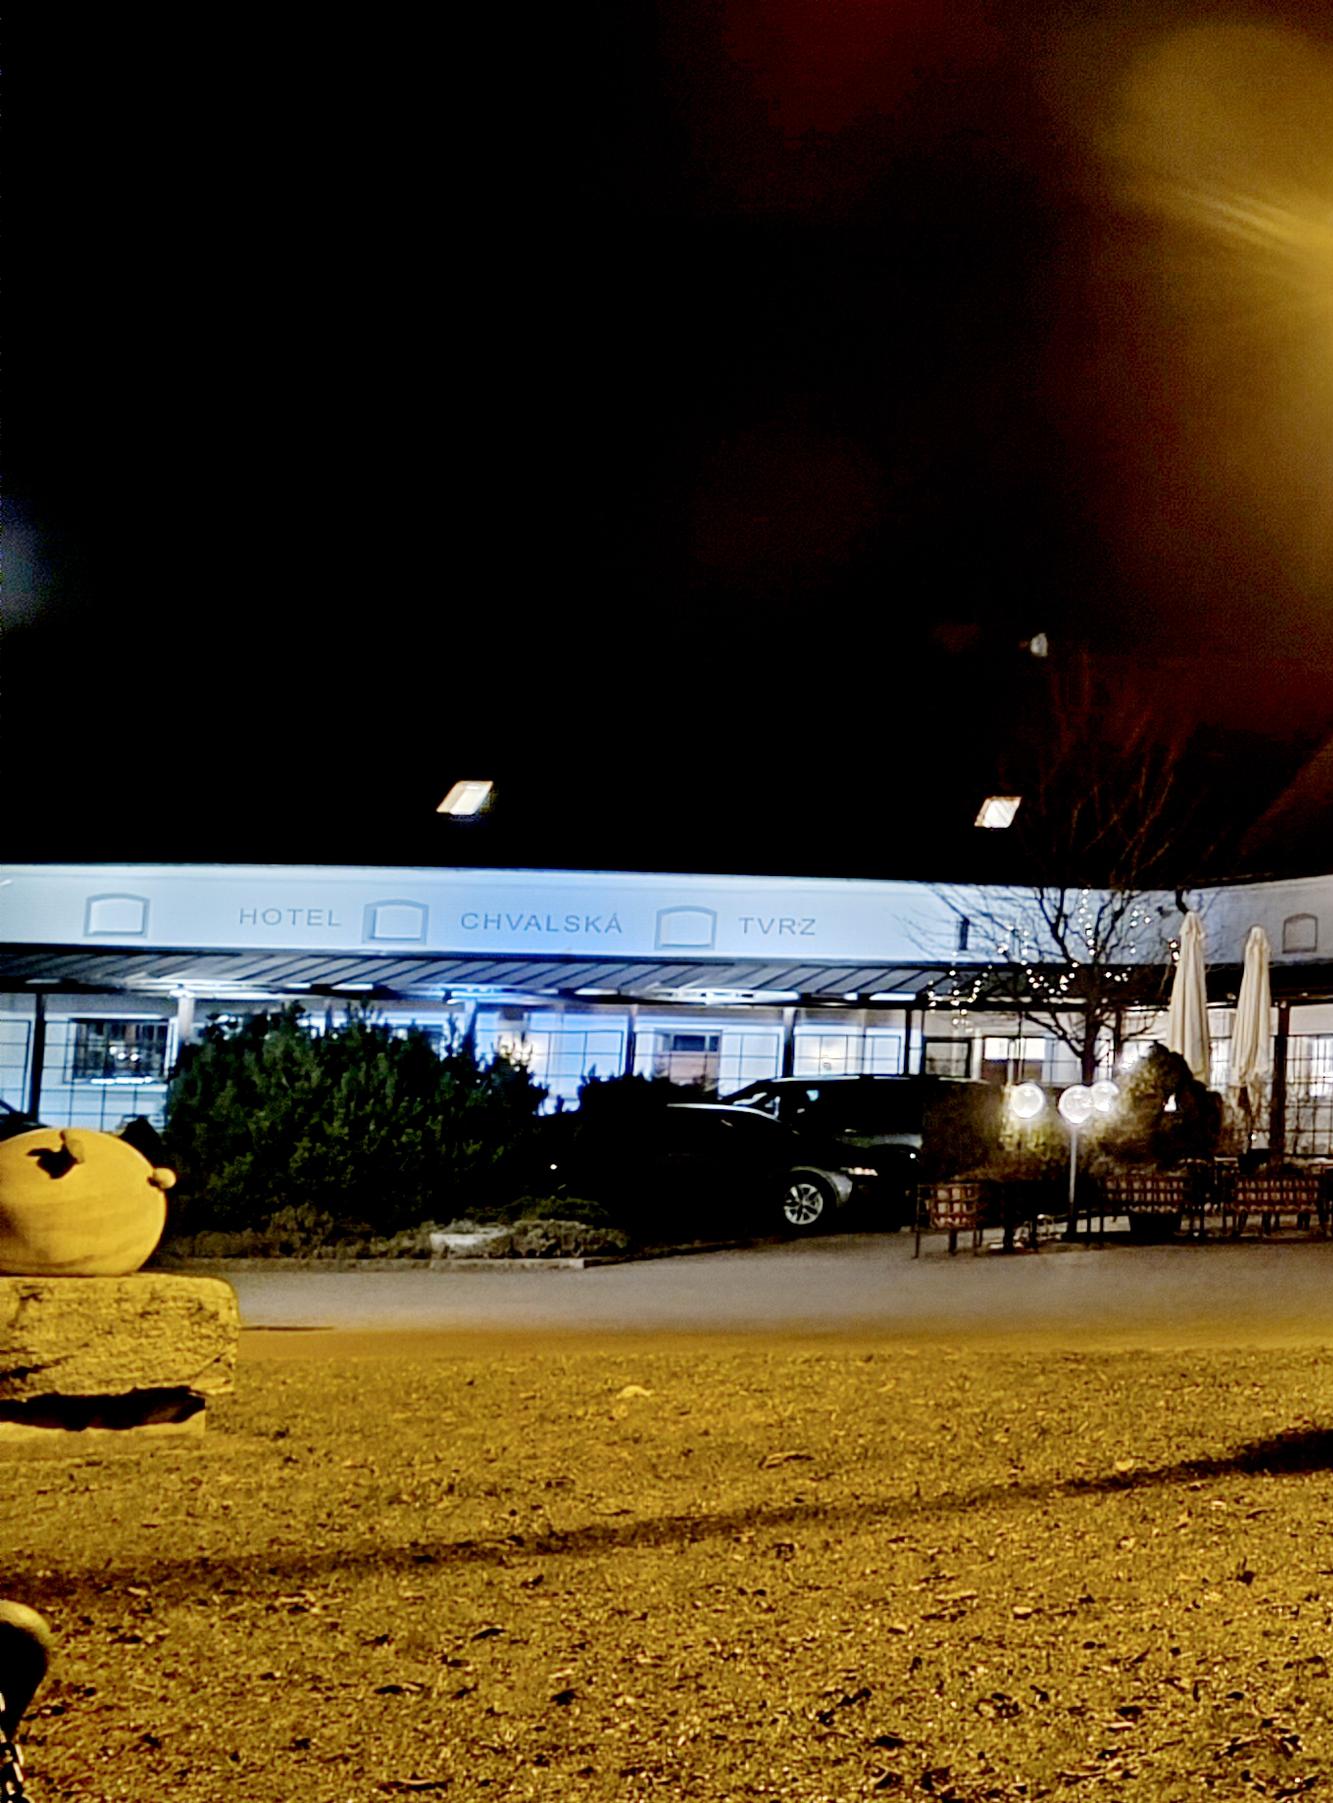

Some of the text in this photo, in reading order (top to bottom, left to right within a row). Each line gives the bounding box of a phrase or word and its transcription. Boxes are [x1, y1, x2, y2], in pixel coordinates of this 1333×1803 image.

[239, 908, 816, 935] HOTEL CHVALSKÁ TVRZ
